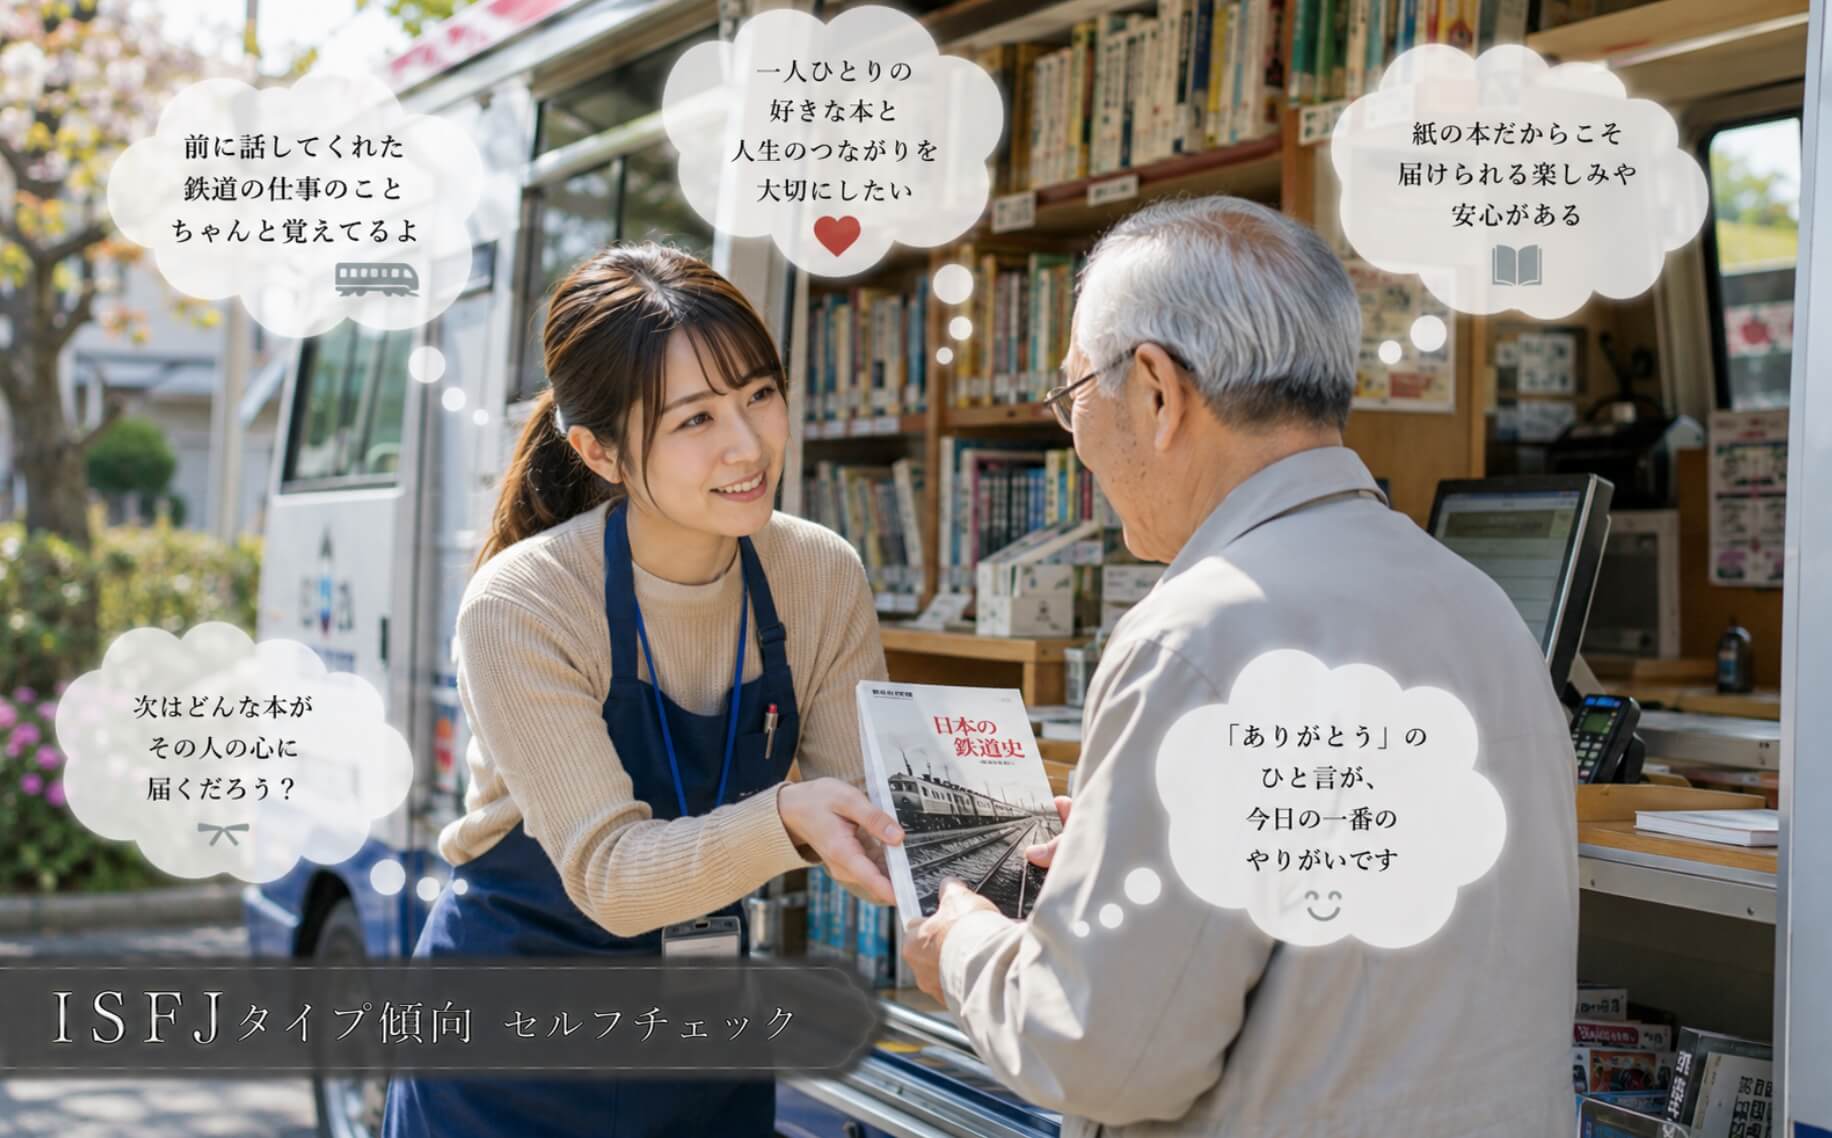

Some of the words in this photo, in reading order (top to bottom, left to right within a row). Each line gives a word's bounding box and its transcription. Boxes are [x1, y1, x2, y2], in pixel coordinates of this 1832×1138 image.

[933, 716, 997, 737] 日本の
[953, 738, 1026, 759] 鉄道史
